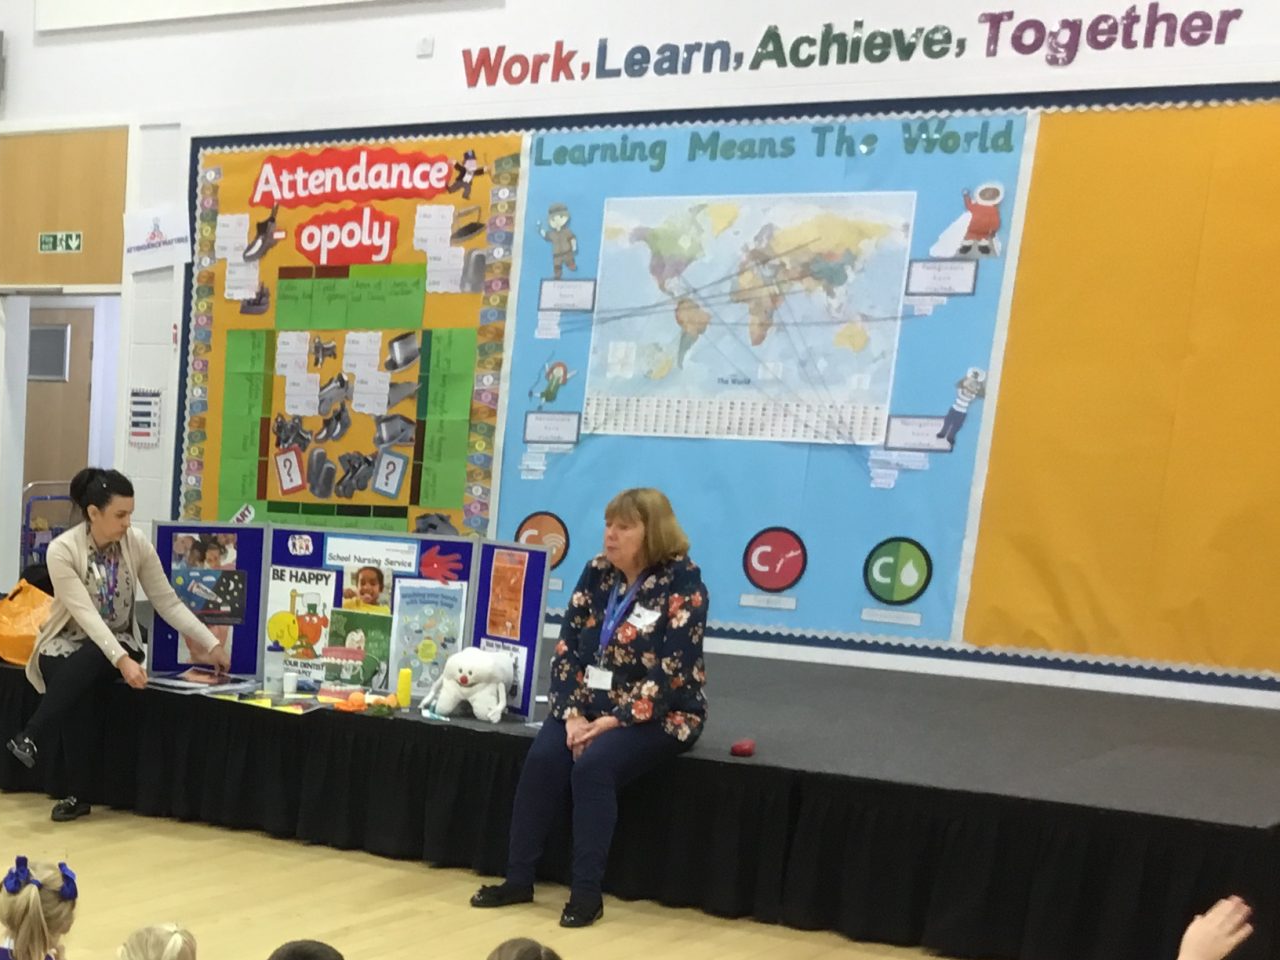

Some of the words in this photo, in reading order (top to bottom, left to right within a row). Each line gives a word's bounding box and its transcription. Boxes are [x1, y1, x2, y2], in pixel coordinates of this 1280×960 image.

[749, 19, 967, 71] Achieve,
[977, 2, 1244, 68] Together
[534, 133, 668, 172] Learning
[688, 131, 796, 162] Means
[812, 125, 879, 157] The
[901, 119, 1015, 155] World
[253, 151, 448, 203] Attendance
[300, 207, 391, 265] opoly
[233, 504, 251, 524] ART
[327, 553, 351, 563] School
[354, 555, 382, 567] Nursing
[384, 558, 412, 568] Service
[751, 545, 772, 572] C
[872, 556, 894, 583] C
[272, 568, 286, 581] BE
[289, 570, 331, 586] HAPPY
